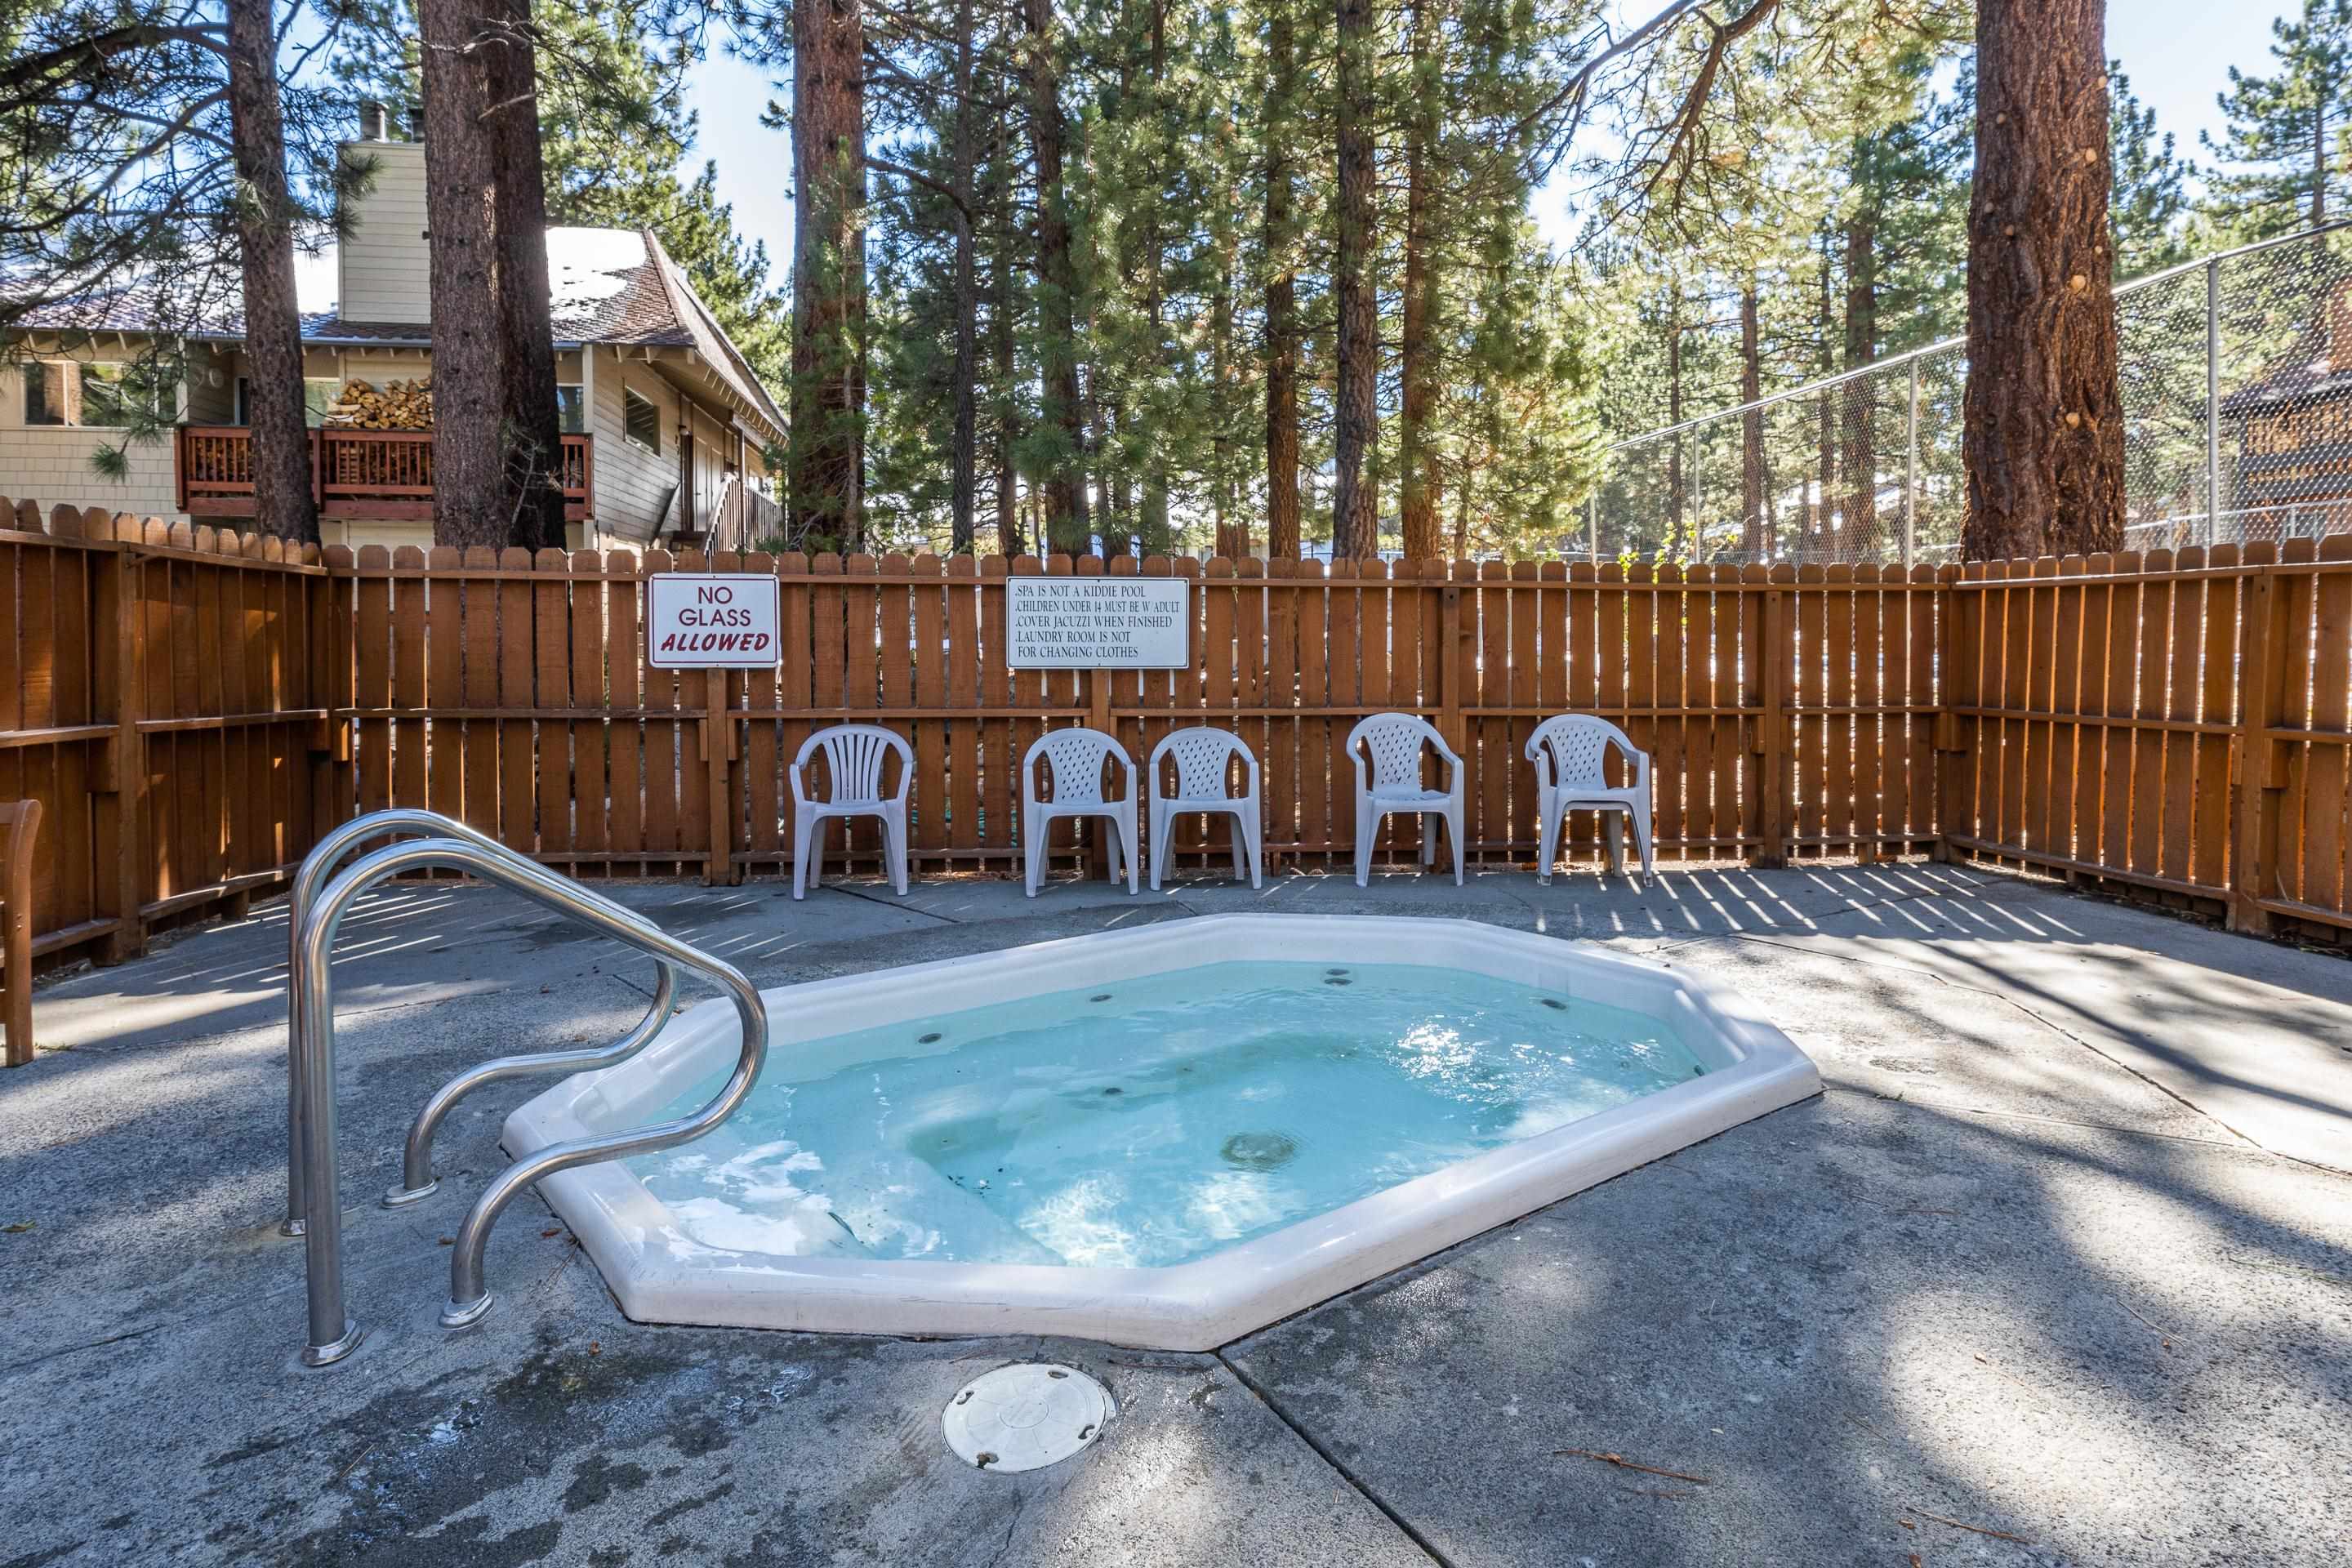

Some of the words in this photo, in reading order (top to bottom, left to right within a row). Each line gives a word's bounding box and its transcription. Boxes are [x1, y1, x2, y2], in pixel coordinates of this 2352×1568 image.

[698, 586, 733, 604] NO
[1038, 585, 1046, 597] IS
[1050, 585, 1070, 597] NOT
[1074, 586, 1080, 597] A
[1084, 586, 1117, 597] KIDDIE
[1121, 586, 1146, 597] POOL
[1062, 601, 1091, 612] UNDER
[1095, 601, 1101, 612] 14
[1105, 601, 1126, 612] MUST
[1129, 601, 1139, 612] BE
[679, 608, 751, 626] GLASS
[1054, 616, 1090, 629] JACUZZI
[1094, 616, 1124, 627] WHEN
[1128, 616, 1173, 628] FINISHED
[660, 633, 769, 651] ALLOWED
[1067, 630, 1095, 643] ROOM
[1099, 631, 1108, 643] IS
[1111, 631, 1131, 643] NOT
[1018, 646, 1036, 657] FOR
[1040, 646, 1092, 657] CHANGING
[1096, 646, 1138, 658] CLOTHES
